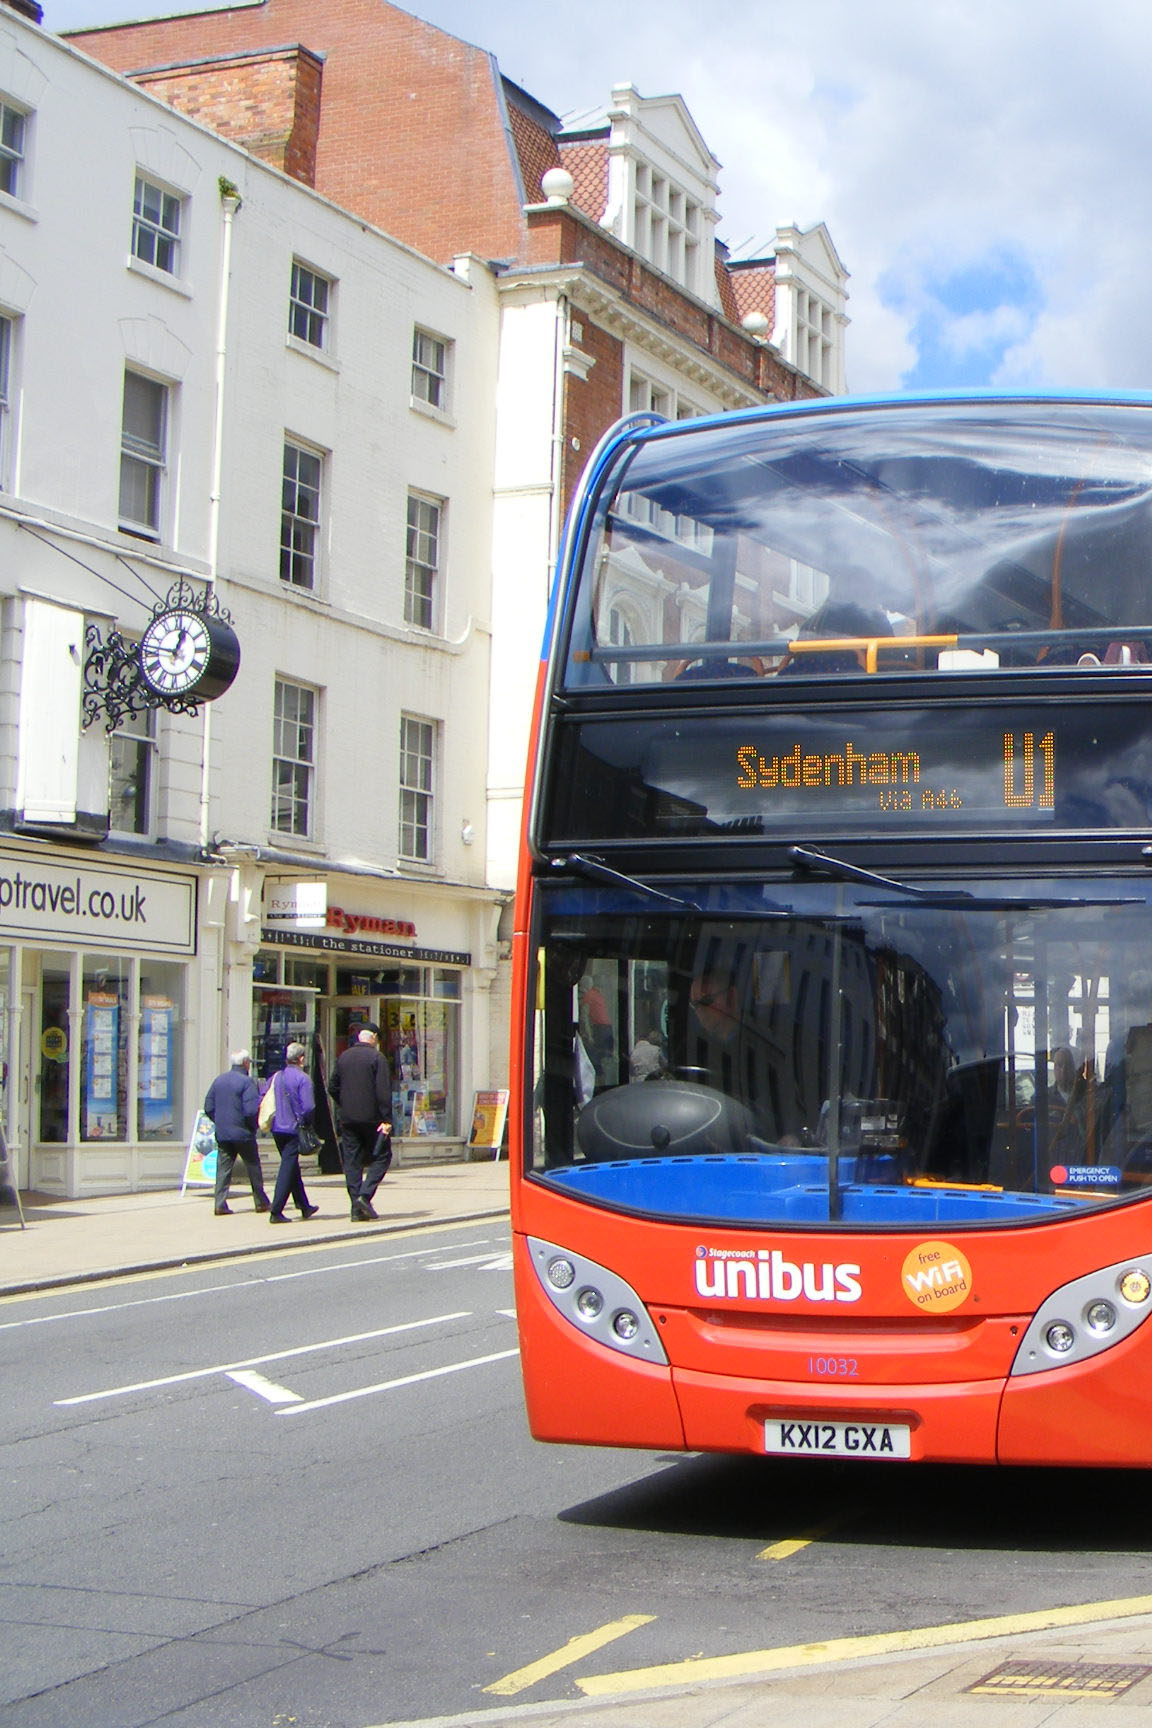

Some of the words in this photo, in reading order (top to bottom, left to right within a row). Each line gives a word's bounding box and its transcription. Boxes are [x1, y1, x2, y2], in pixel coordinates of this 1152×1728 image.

[737, 742, 921, 788] Sydenham
[1003, 732, 1055, 807] U1
[922, 789, 963, 810] A46
[327, 906, 417, 938] Ryman
[322, 937, 346, 951] the
[351, 942, 414, 959] stationer
[1069, 1167, 1111, 1175] EMERGENCY
[1069, 1174, 1087, 1182] PUSH
[1088, 1174, 1098, 1182] TO
[1099, 1174, 1118, 1182] OPEN
[708, 1247, 756, 1258] Stagecoach
[918, 1250, 941, 1265] free
[695, 1250, 862, 1302] unibus
[906, 1260, 963, 1291] WiFi
[917, 1293, 932, 1304] on
[933, 1280, 967, 1300] board
[808, 1357, 860, 1377] 10032
[780, 1424, 836, 1450] KX12
[844, 1426, 894, 1452] GXA
